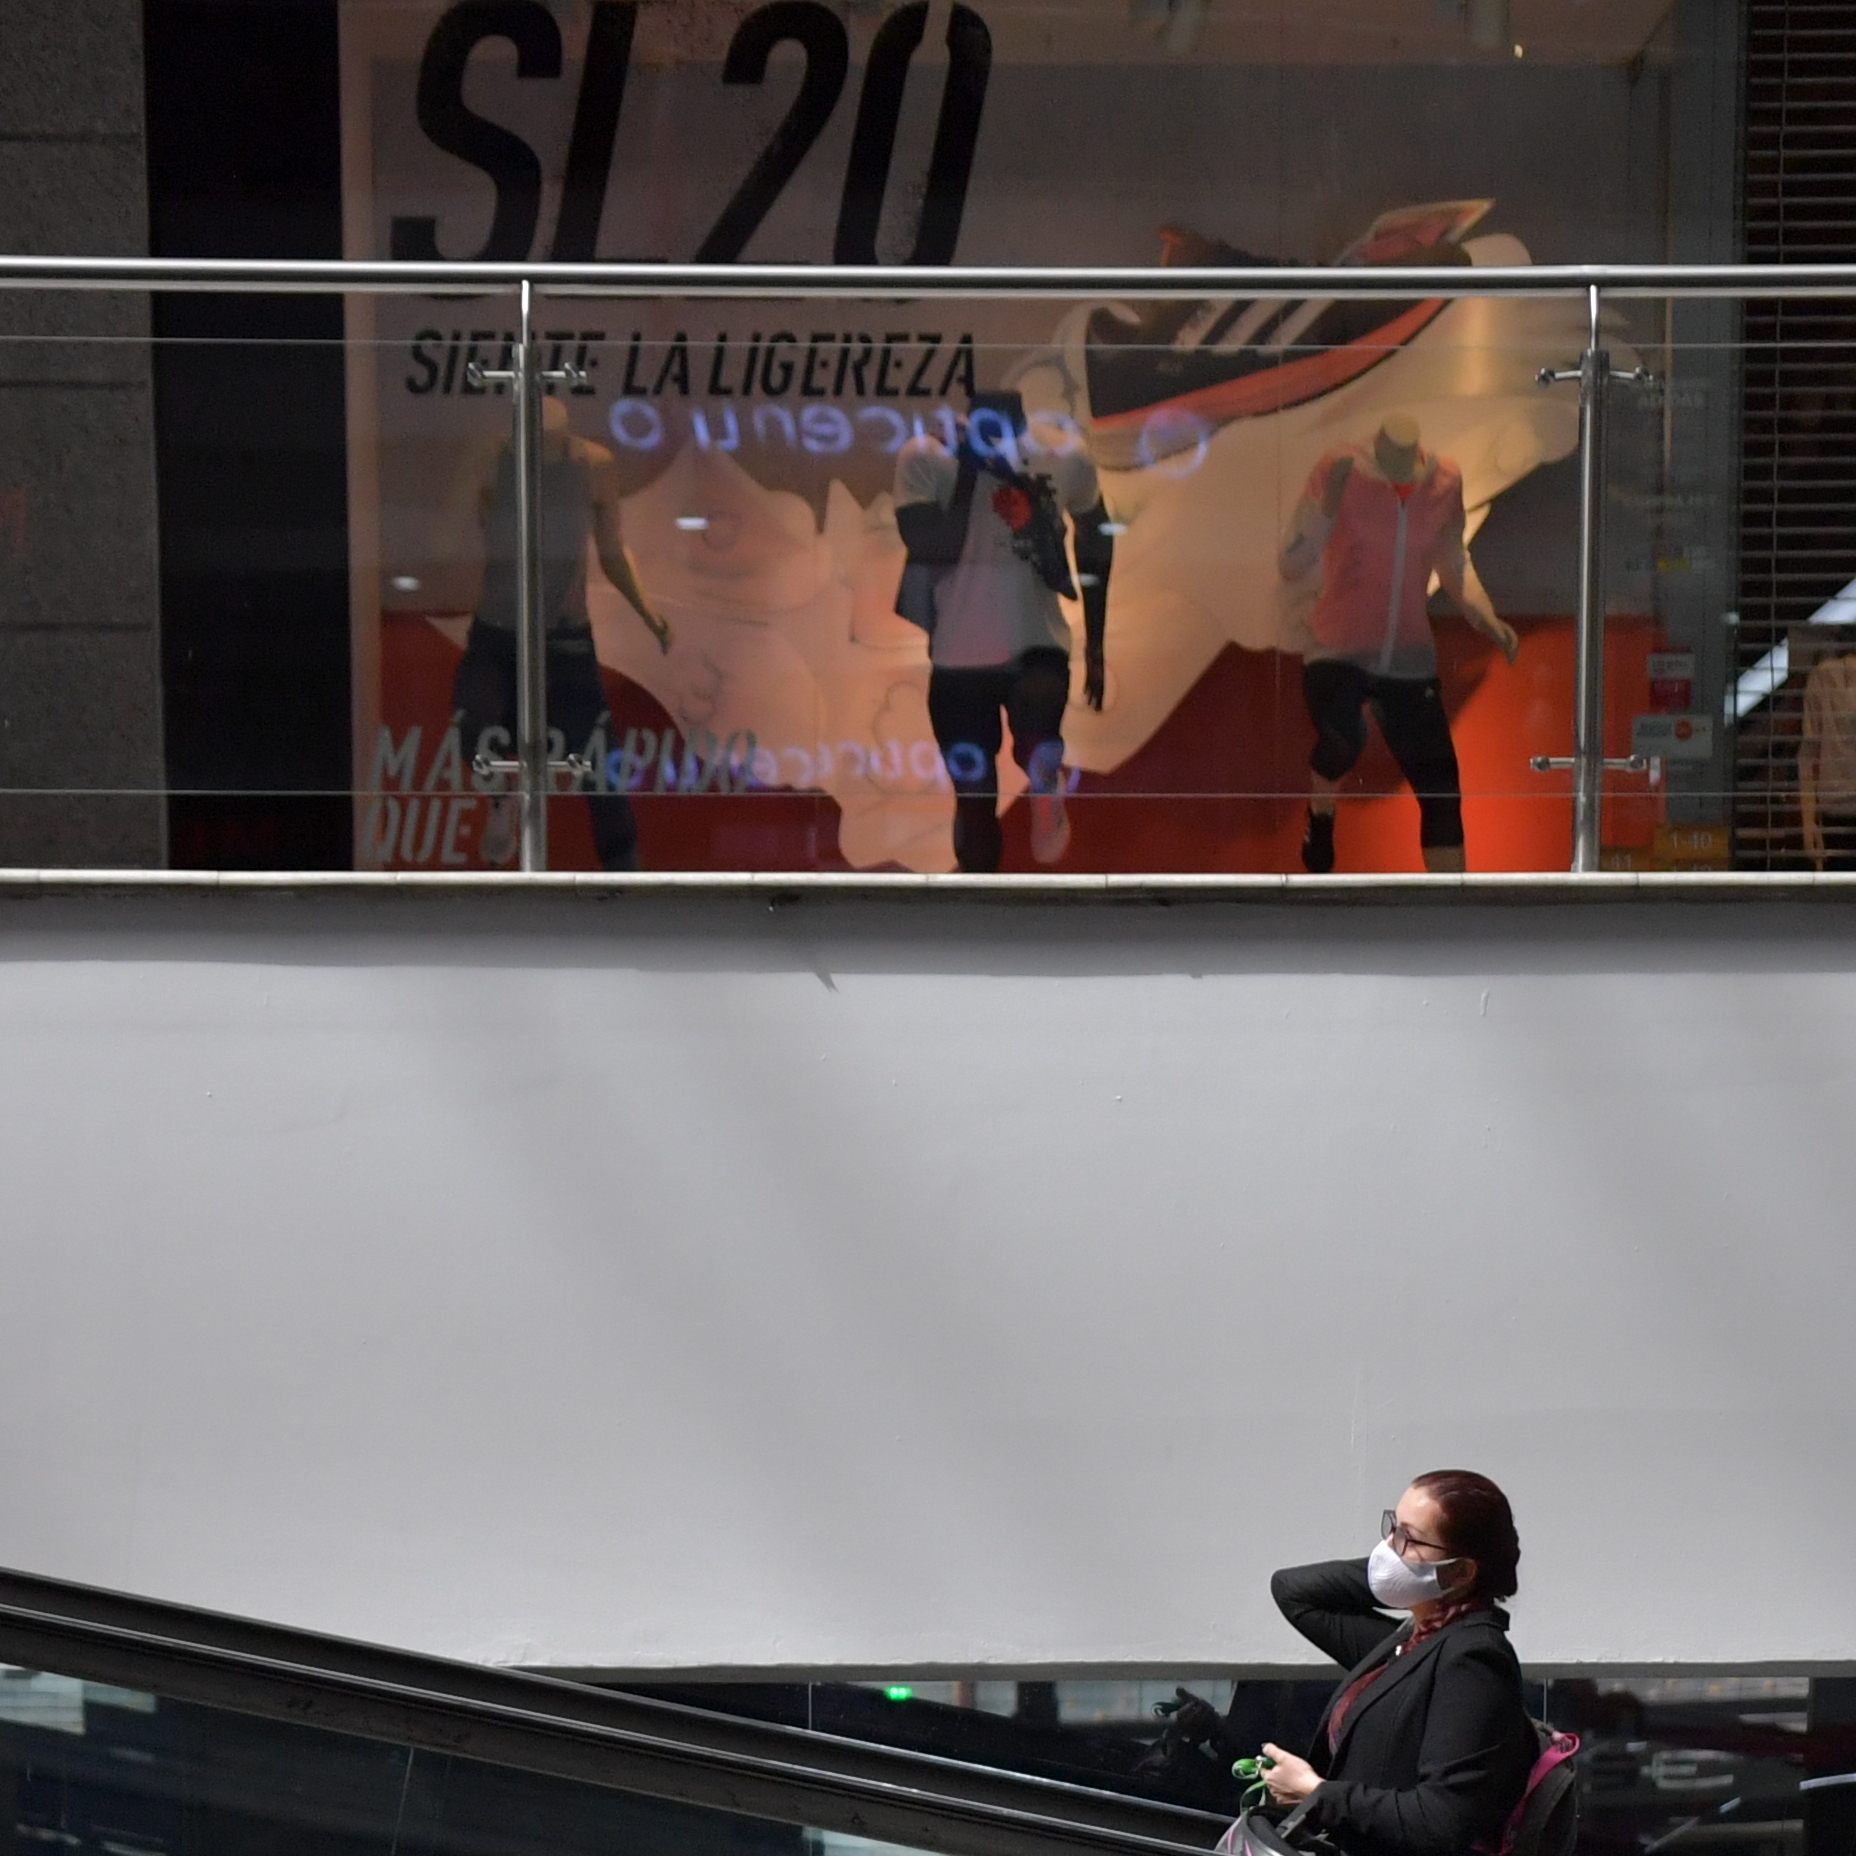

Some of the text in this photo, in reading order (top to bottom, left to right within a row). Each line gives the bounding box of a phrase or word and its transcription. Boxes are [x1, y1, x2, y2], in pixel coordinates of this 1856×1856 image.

[390, 0, 992, 303] SL20
[623, 331, 691, 396] LA
[708, 332, 976, 397] LIGEREZA
[366, 709, 758, 794] MÁS RÁPIDO
[362, 797, 478, 866] QUE
